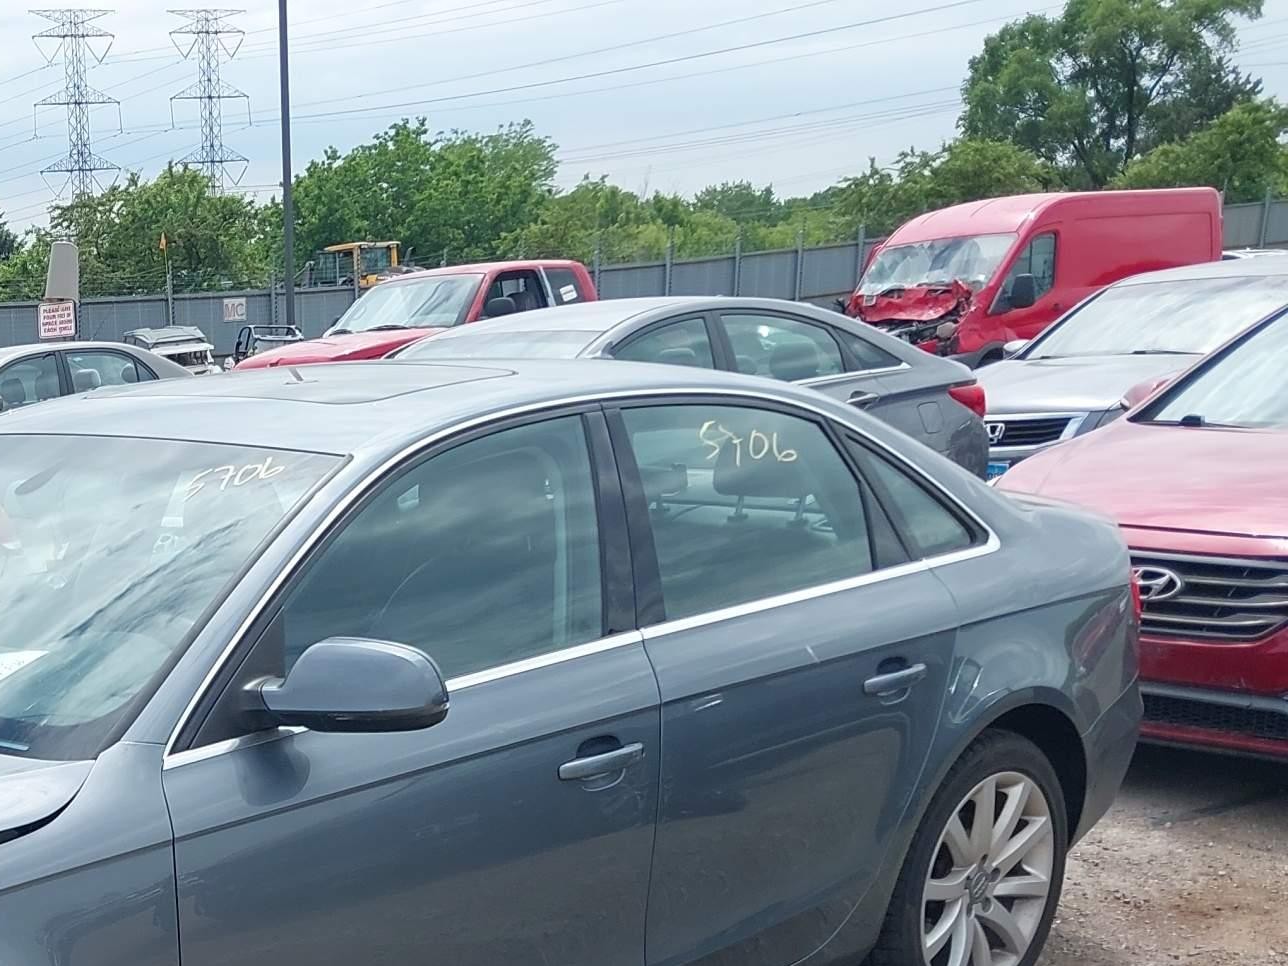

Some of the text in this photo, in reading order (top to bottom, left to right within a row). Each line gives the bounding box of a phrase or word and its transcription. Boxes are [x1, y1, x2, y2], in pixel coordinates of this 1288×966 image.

[224, 303, 245, 318] MC
[699, 420, 797, 467] 5706
[183, 456, 286, 502] 5706
